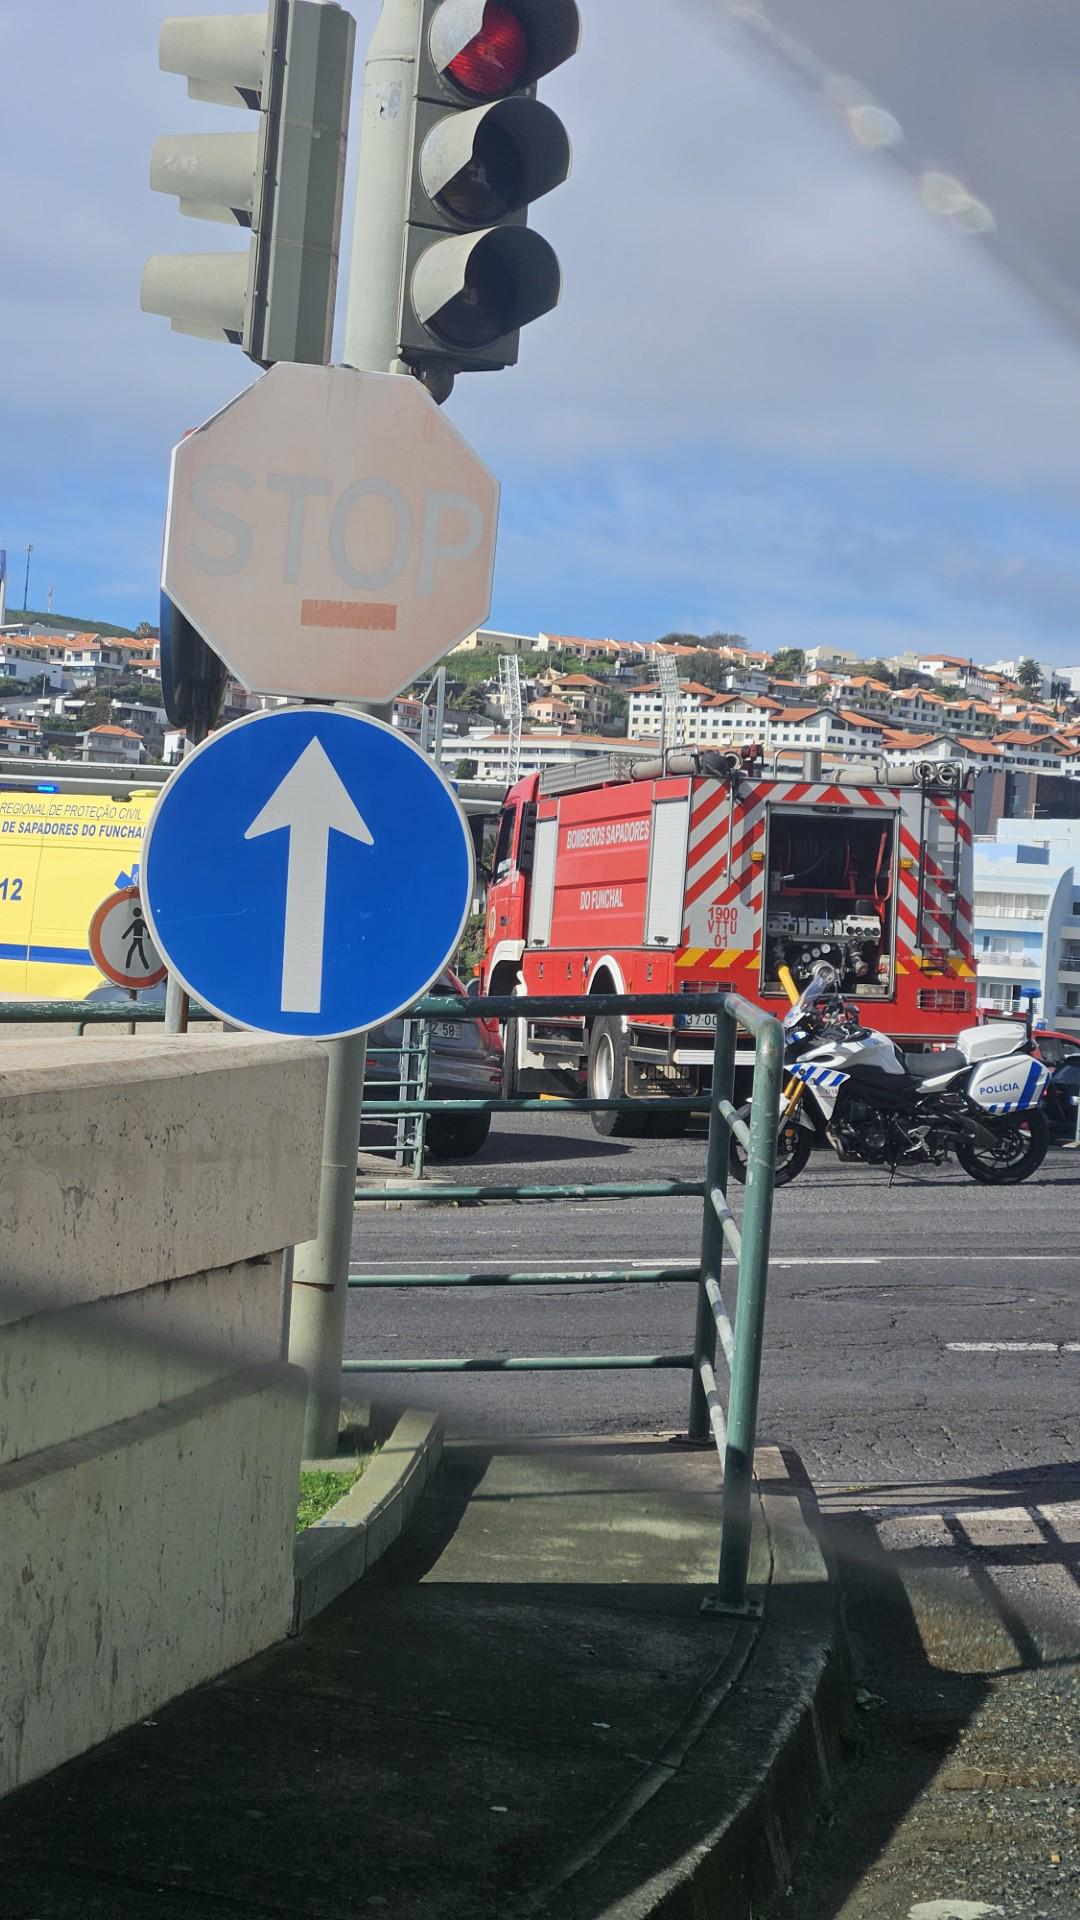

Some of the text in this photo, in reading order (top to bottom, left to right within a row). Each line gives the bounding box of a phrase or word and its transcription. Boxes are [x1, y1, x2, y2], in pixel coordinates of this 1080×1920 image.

[184, 463, 484, 596] STOP
[0, 802, 142, 821] REGIONAL DE PROTEÇÃO CIVIL
[1, 821, 16, 833] DE
[18, 821, 78, 837] SAPADORES
[81, 823, 96, 837] DO
[567, 820, 650, 849] BOMBEIROS SAPADORES
[580, 888, 624, 910] DO FUNCHAL
[708, 907, 738, 920] 1900
[708, 920, 737, 934] VTTU
[714, 934, 728, 947] 01
